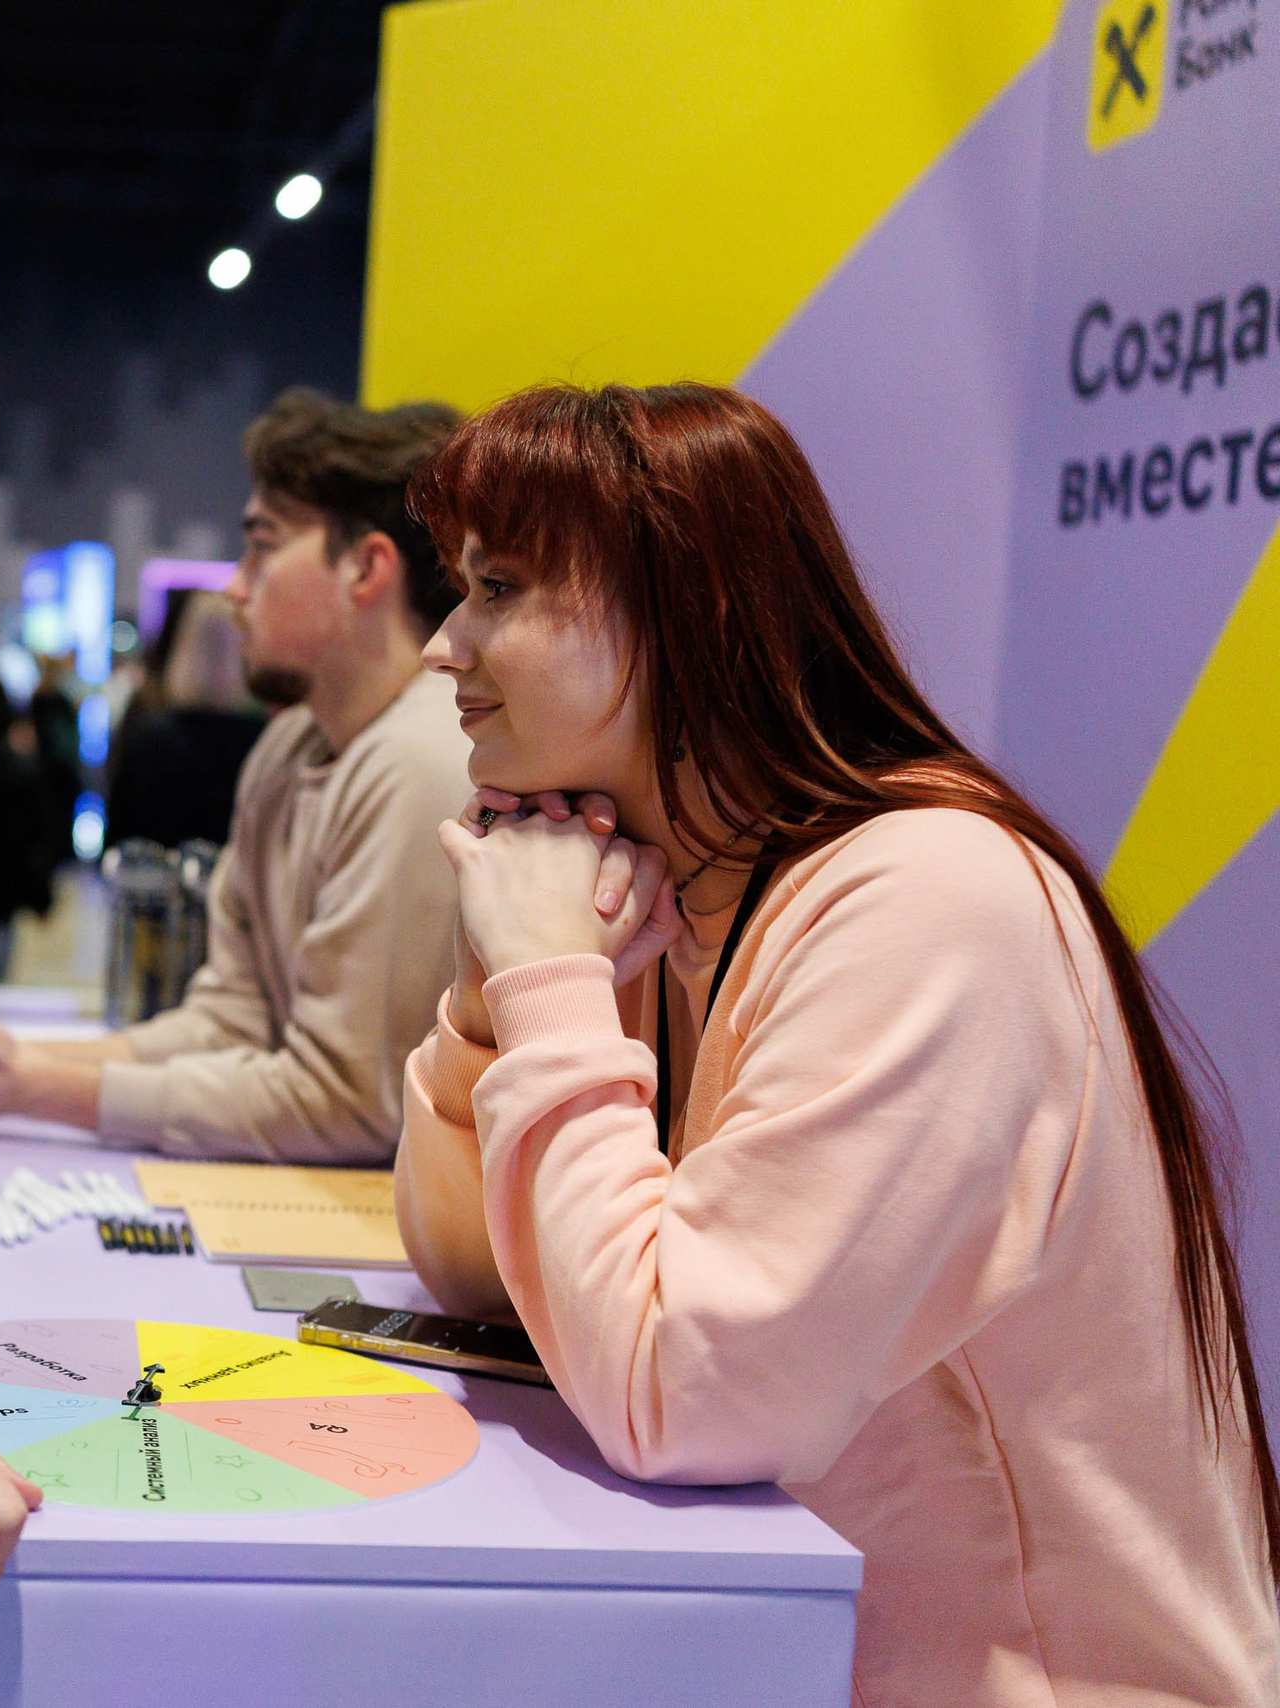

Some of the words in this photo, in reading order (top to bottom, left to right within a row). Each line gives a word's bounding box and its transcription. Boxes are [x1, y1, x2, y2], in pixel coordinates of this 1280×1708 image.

[1071, 282, 1280, 400] Созда
[179, 1367, 238, 1390] данных
[141, 1418, 161, 1447] анализ
[309, 1422, 349, 1434] QA
[138, 1449, 166, 1502] Системный
